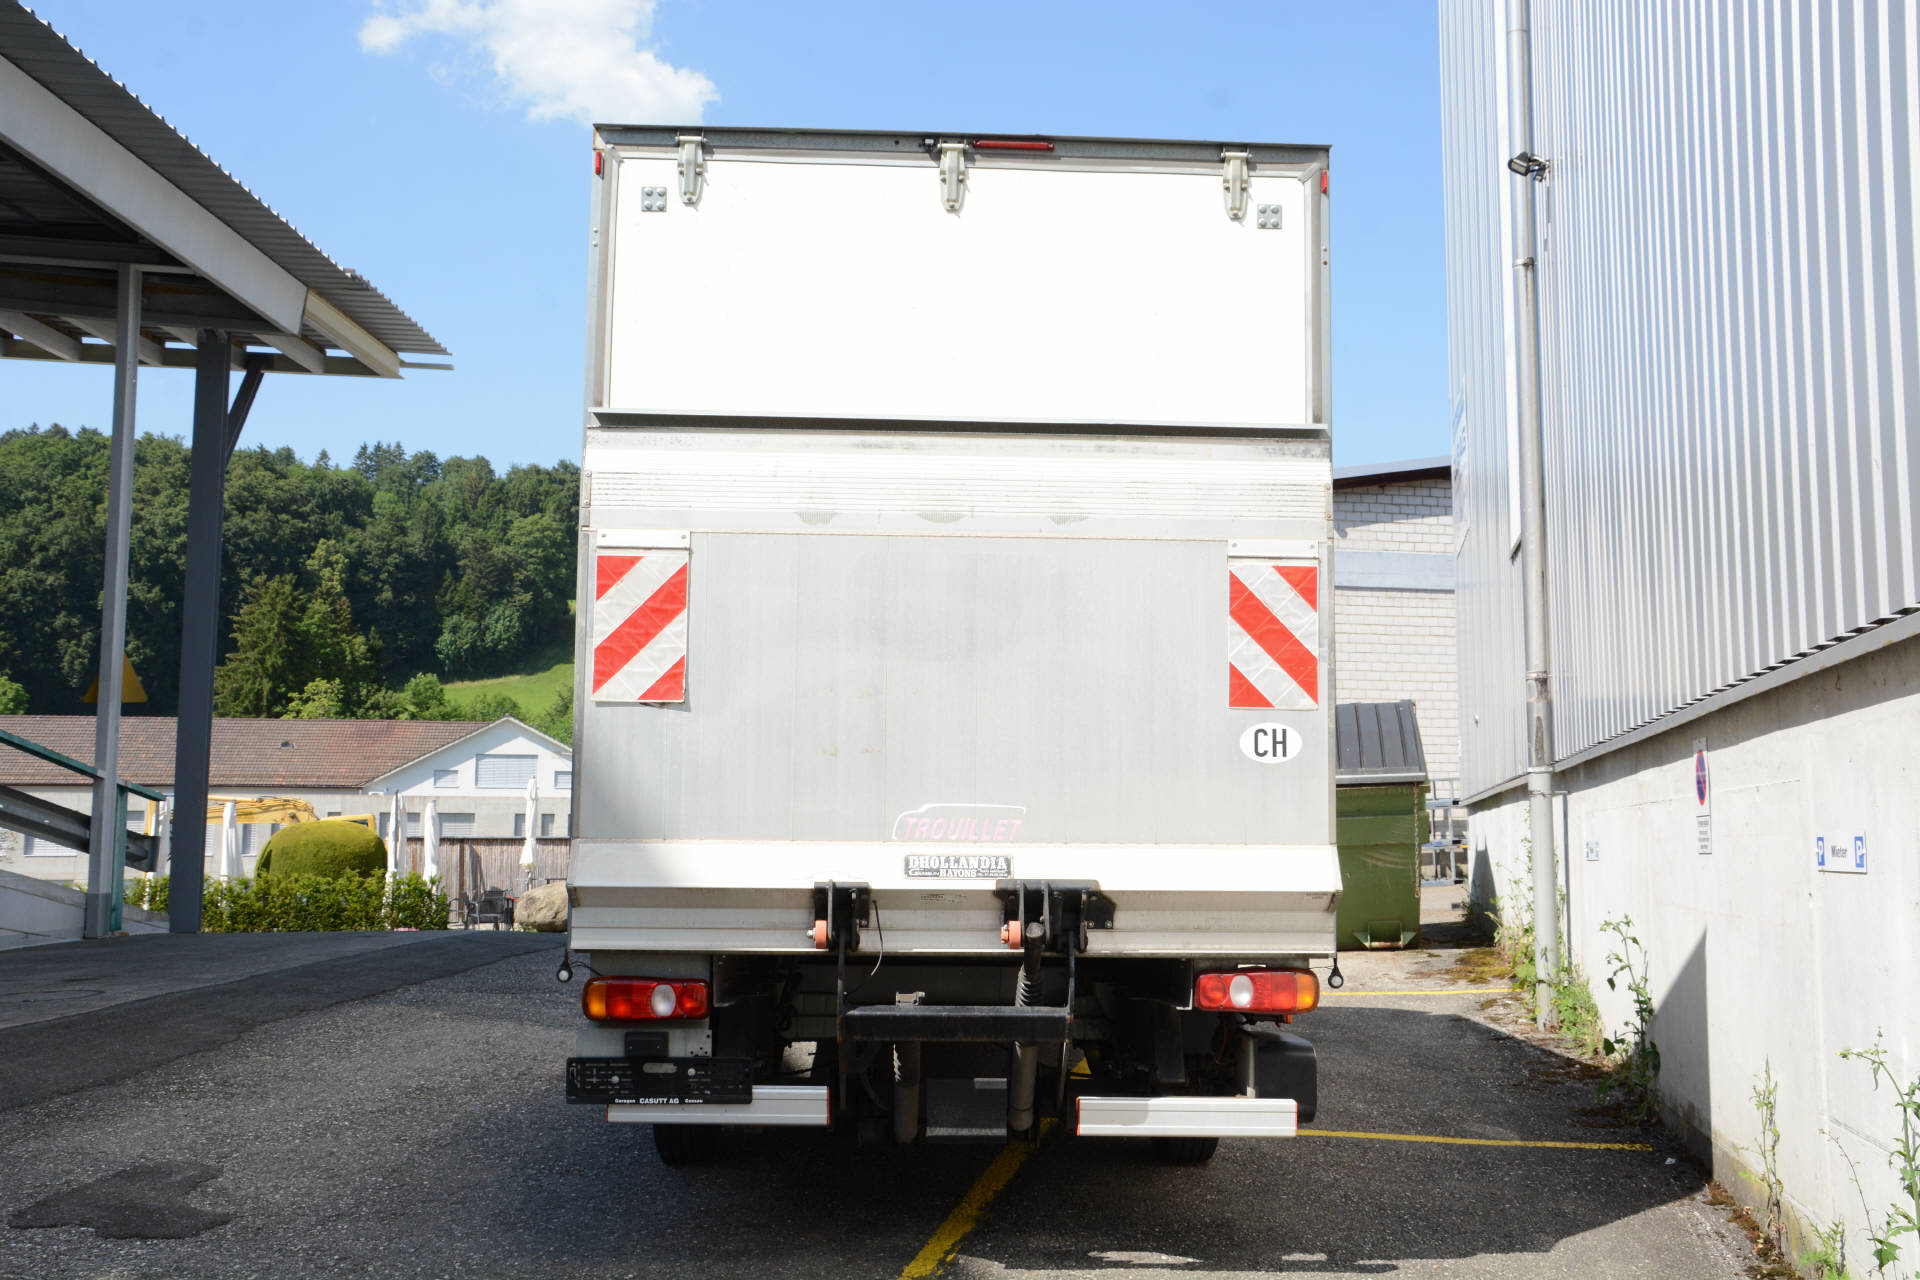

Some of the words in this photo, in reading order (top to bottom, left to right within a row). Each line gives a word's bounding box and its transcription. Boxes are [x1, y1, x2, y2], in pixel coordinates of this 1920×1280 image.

[1254, 728, 1287, 757] CH
[904, 817, 1025, 841] TROUILLET
[908, 855, 1008, 869] DHOLLANDIA
[939, 868, 977, 878] HAYONS
[639, 1097, 667, 1105] CASUTT
[669, 1097, 680, 1105] AG
